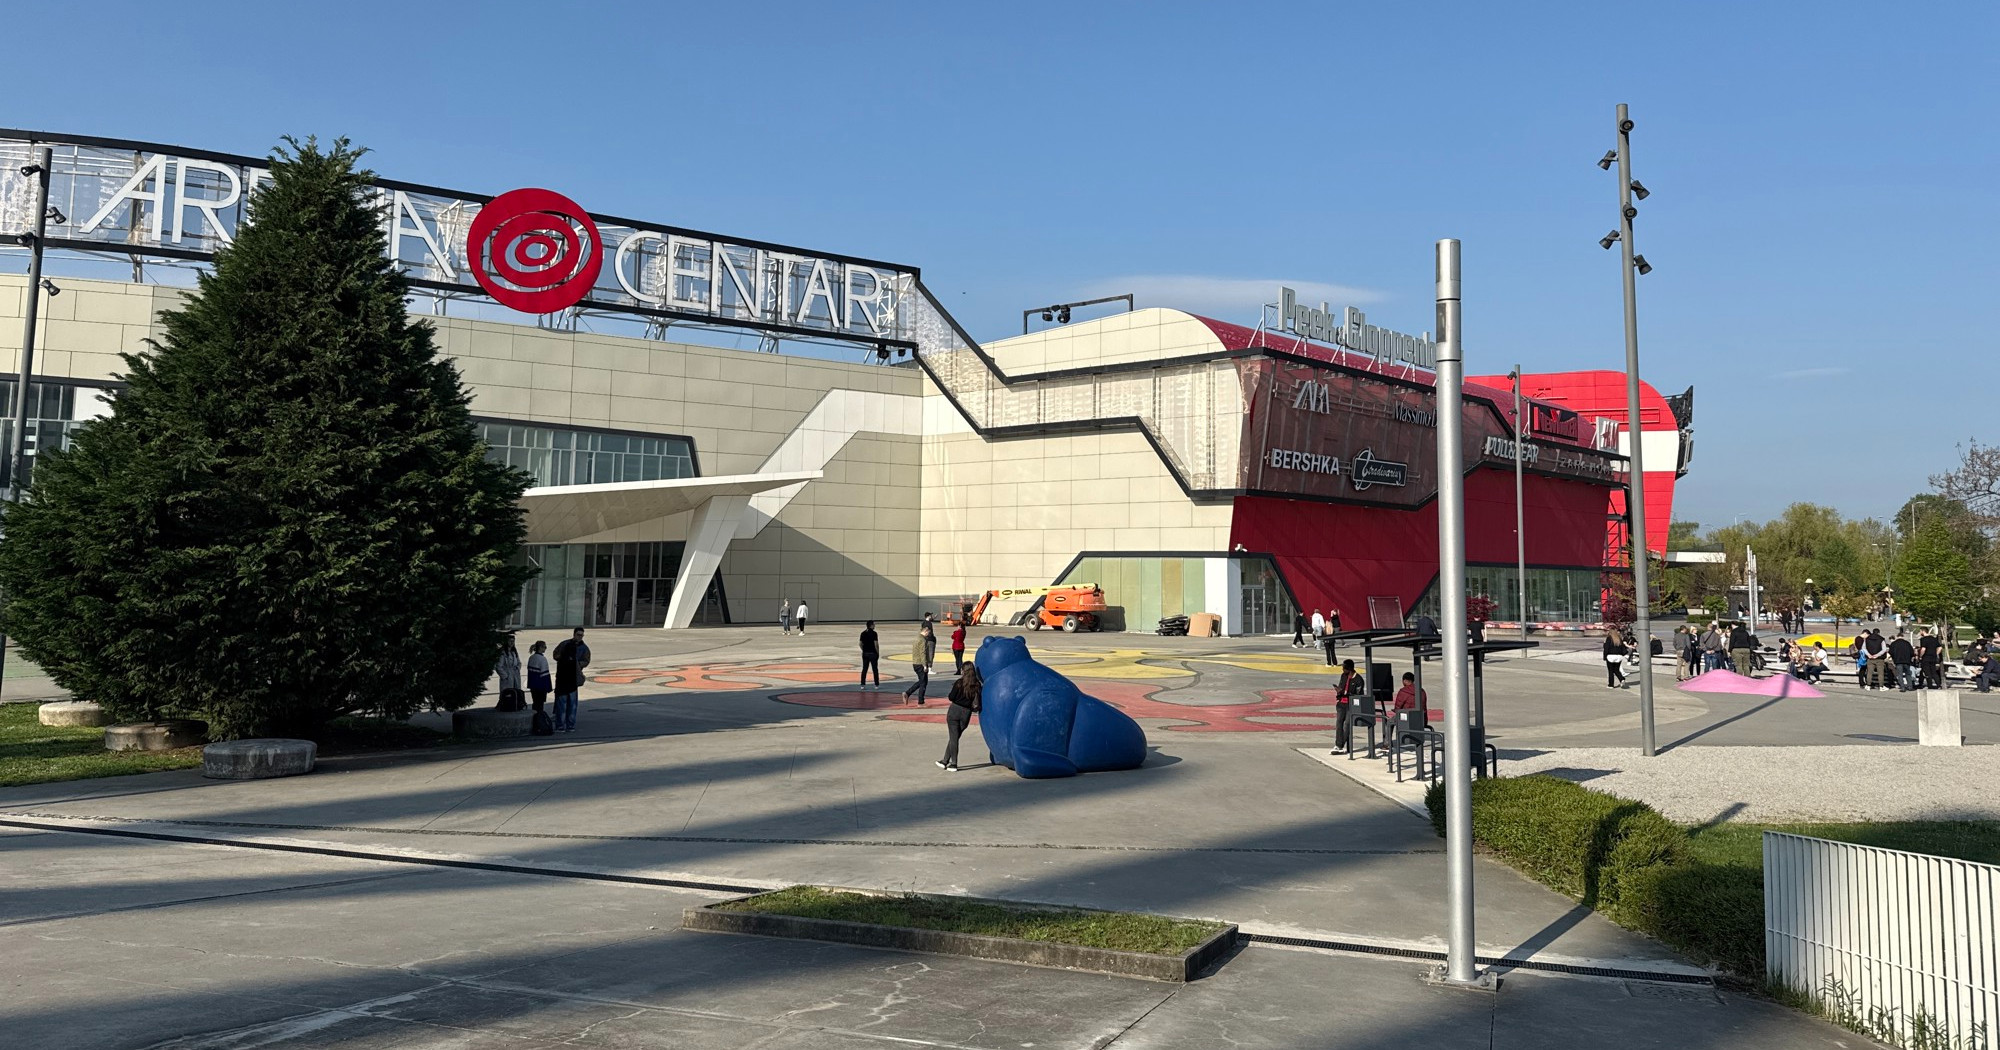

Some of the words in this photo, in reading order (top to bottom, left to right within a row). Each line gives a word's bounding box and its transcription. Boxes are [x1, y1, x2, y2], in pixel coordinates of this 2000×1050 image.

[79, 153, 456, 278] ARA
[614, 231, 880, 333] CENTAR
[1278, 286, 1337, 344] Peek
[1344, 306, 1436, 368] Cloppenb
[1292, 379, 1330, 414] ZARA
[1393, 400, 1430, 427] Massimo
[1271, 448, 1340, 475] BERSHKA
[1484, 436, 1540, 463] PULL&EAR
